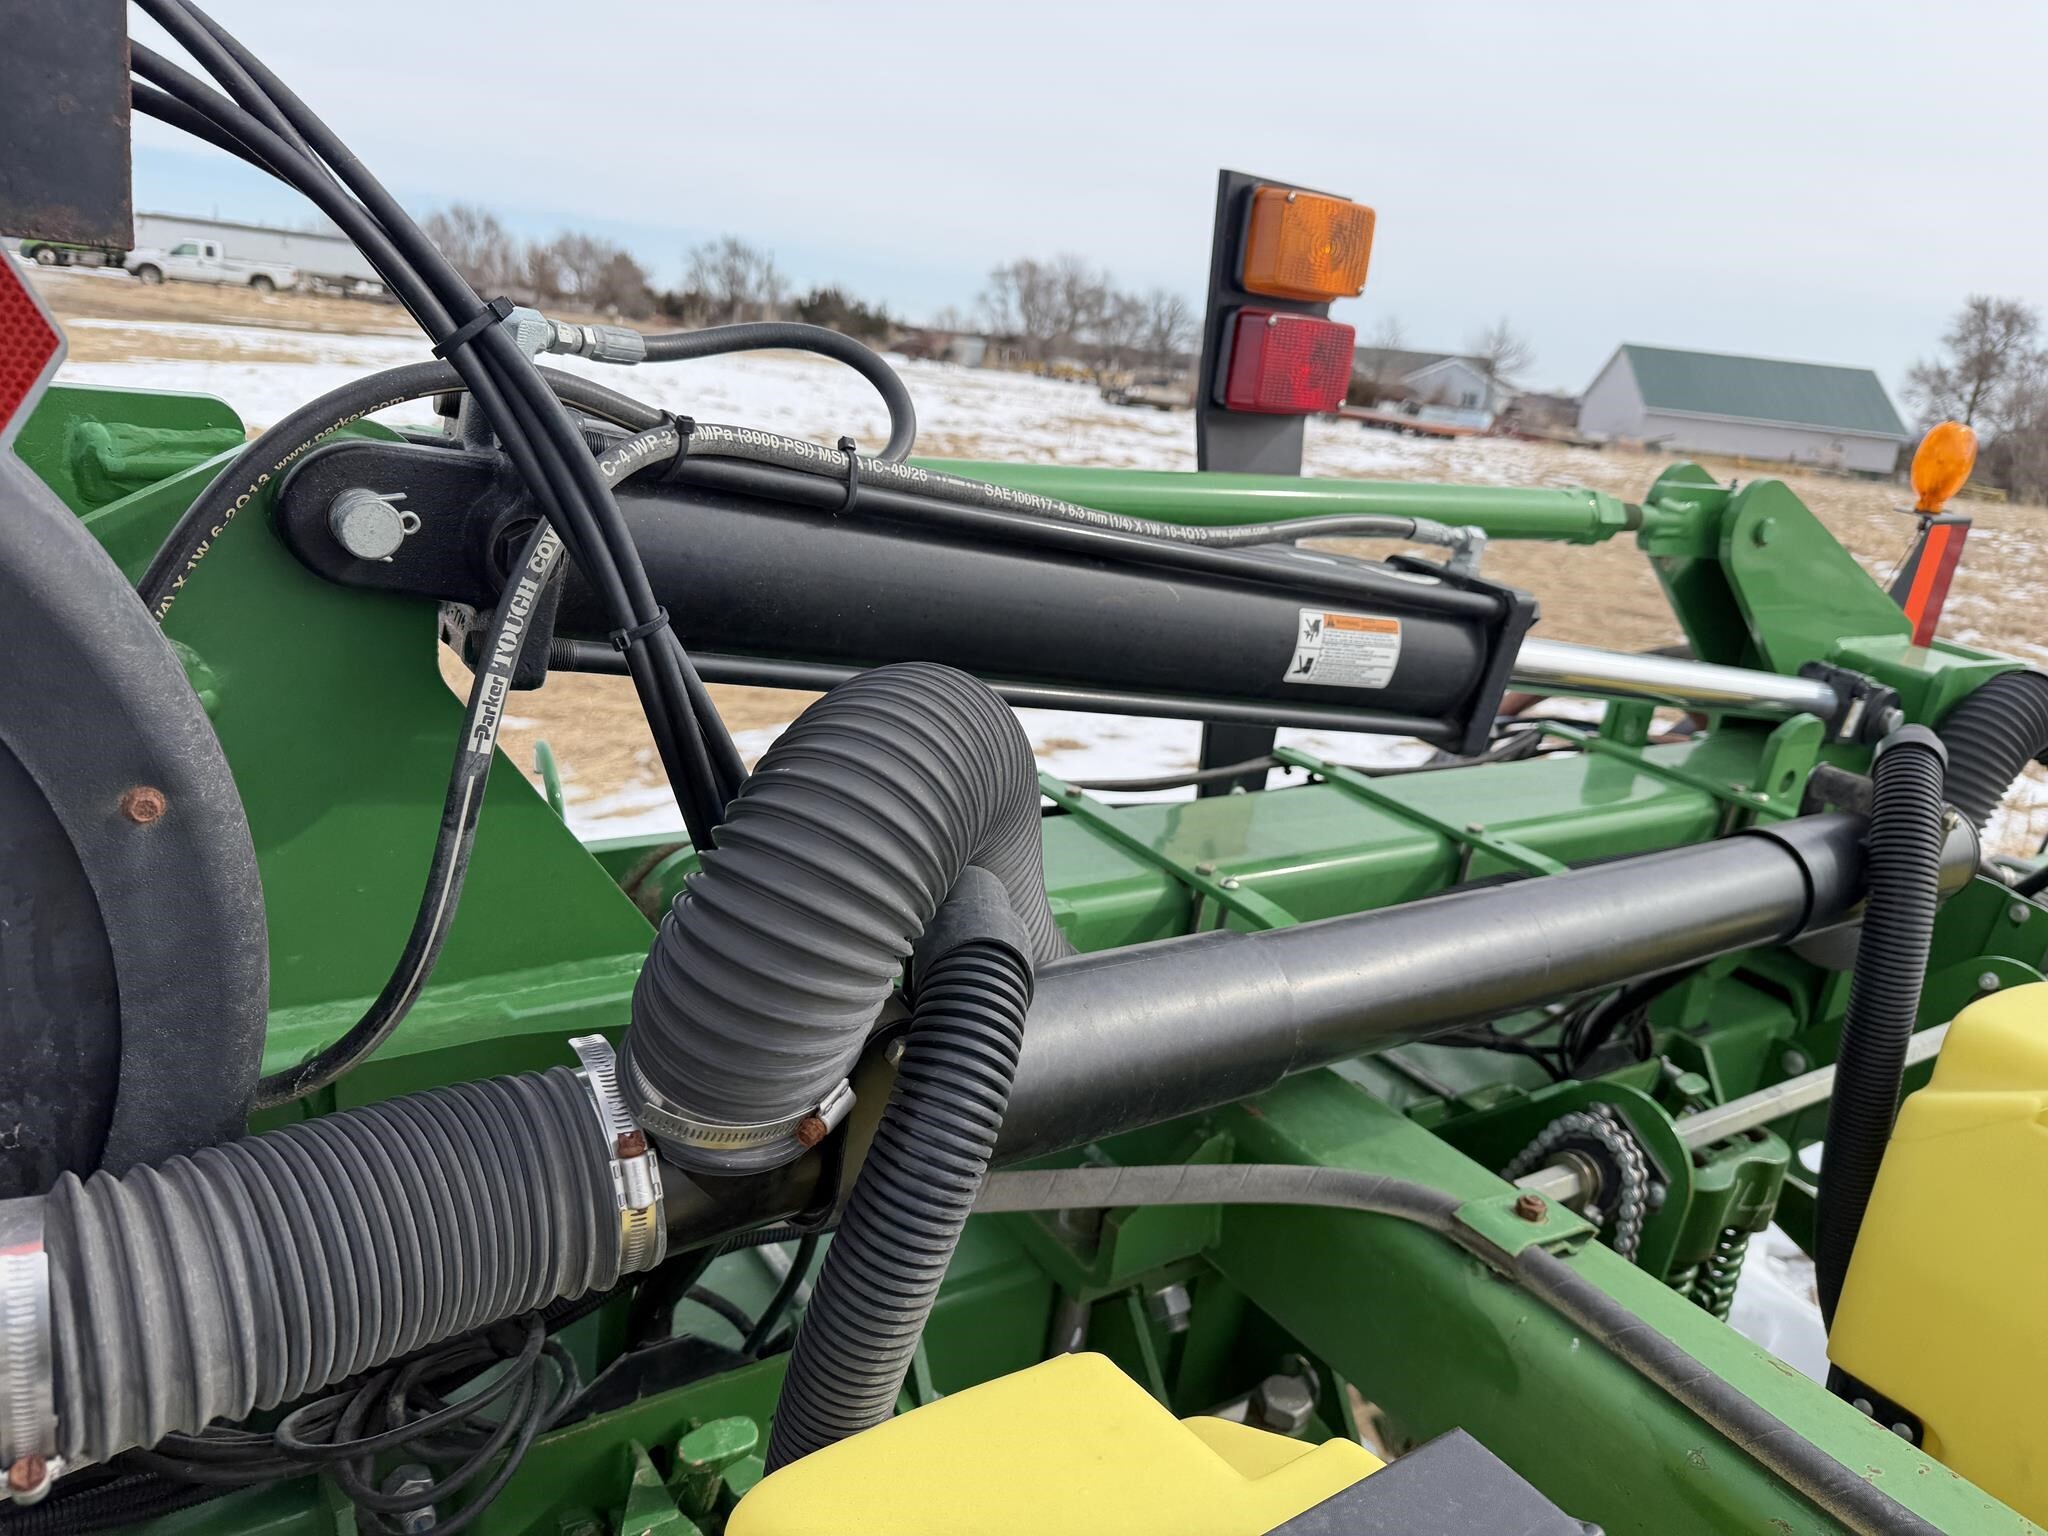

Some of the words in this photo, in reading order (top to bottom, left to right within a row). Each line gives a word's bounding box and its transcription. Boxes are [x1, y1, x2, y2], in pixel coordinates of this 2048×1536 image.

[172, 574, 188, 589] X
[187, 540, 210, 570] 1W
[273, 396, 405, 471] www.parker.com
[600, 449, 631, 477] C-4
[629, 434, 659, 456] WP
[696, 425, 734, 441] MPa
[784, 438, 814, 459] PSI)
[1087, 511, 1107, 525] mm
[1134, 519, 1143, 532] X
[1145, 523, 1160, 535] 1W
[474, 676, 505, 753] Parker
[491, 576, 539, 668] TOUGH
